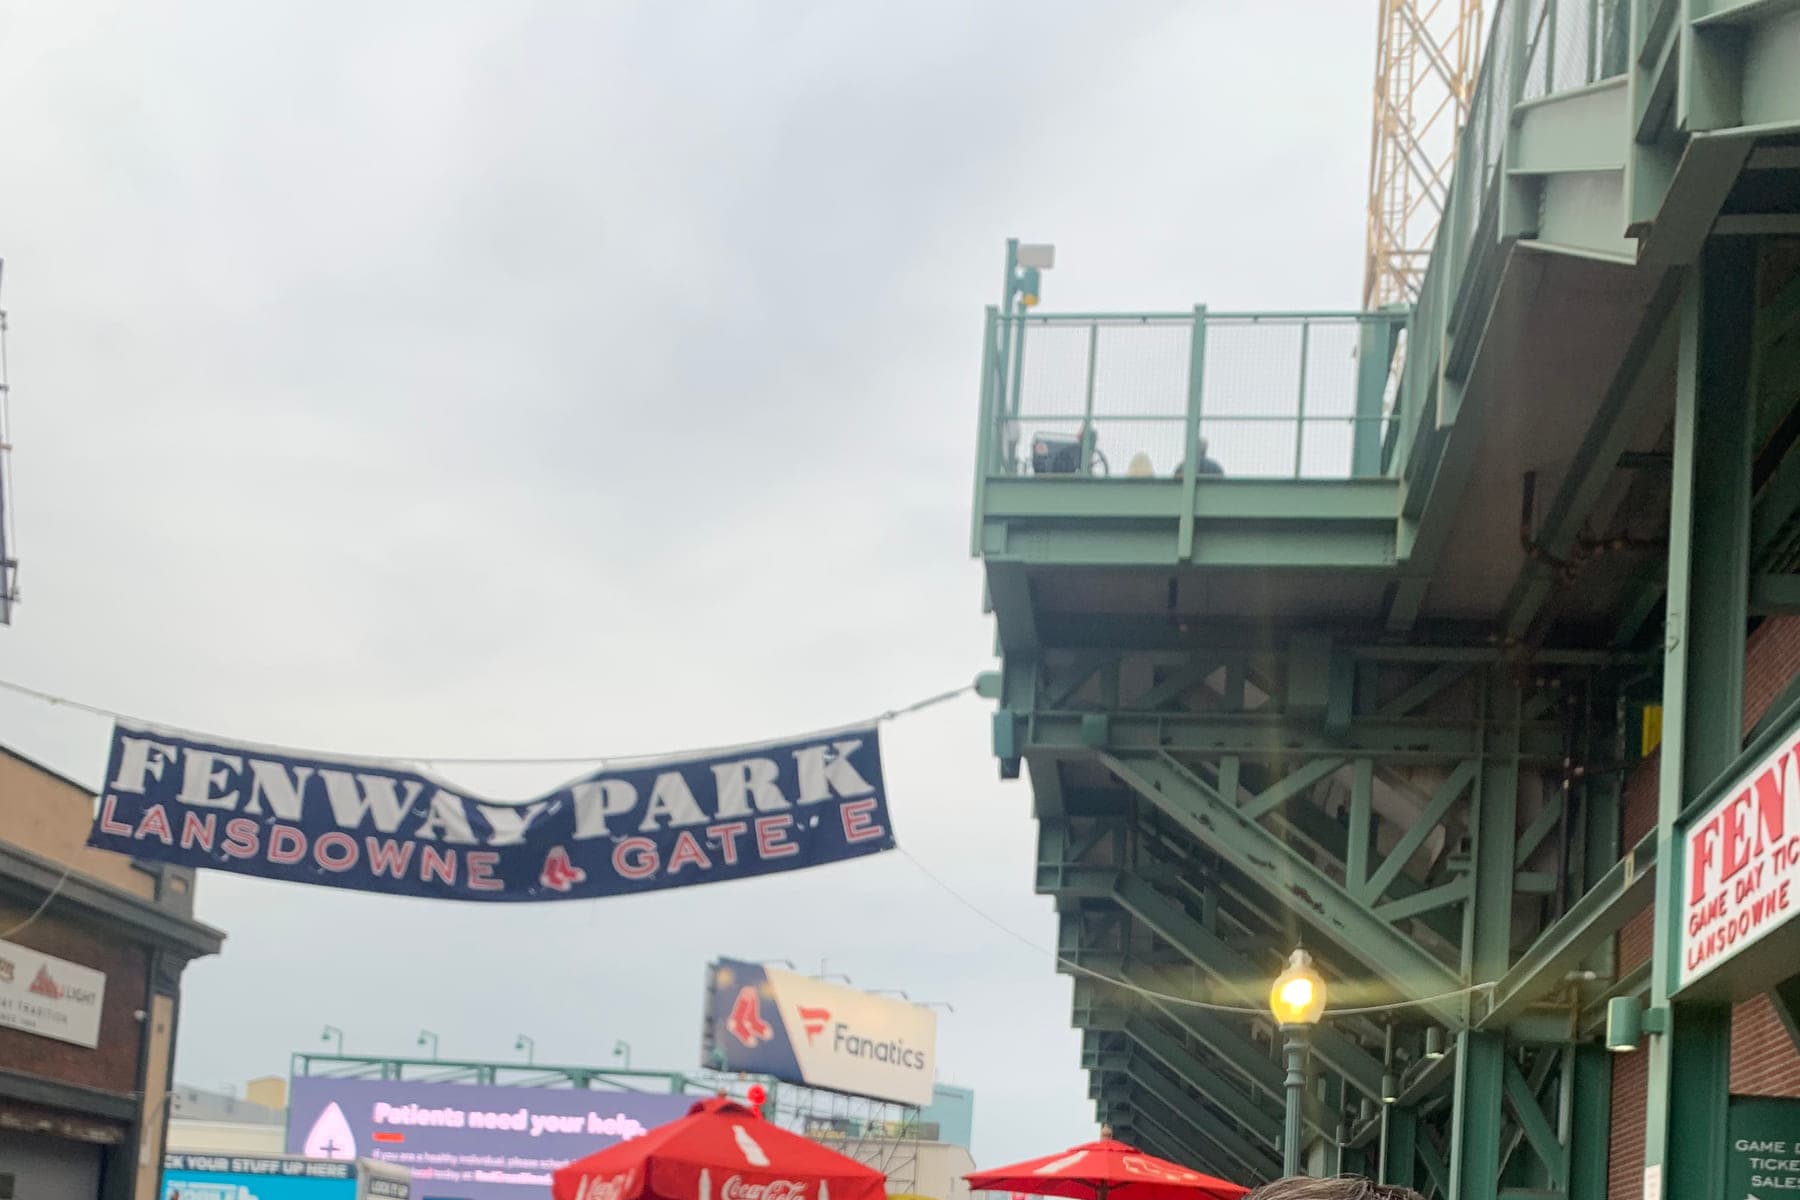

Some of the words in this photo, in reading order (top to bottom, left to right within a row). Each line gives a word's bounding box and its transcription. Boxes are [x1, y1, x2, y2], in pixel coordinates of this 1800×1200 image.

[110, 735, 549, 846] FENWAY
[572, 739, 875, 840] PARK
[101, 794, 505, 891] LANSDOWNE
[612, 814, 798, 879] GATE
[841, 798, 883, 843] E
[1690, 740, 1800, 906] FEN
[1687, 878, 1790, 971] LANSDOWNE
[1689, 889, 1728, 937] GAME
[1735, 861, 1763, 904] DAY
[833, 1022, 925, 1071] Fanatics
[373, 1102, 465, 1128] Patients
[468, 1108, 528, 1131] need
[530, 1113, 586, 1137] your
[1735, 1139, 1786, 1154] GAME
[188, 1156, 228, 1172] YOUR
[231, 1159, 280, 1174] STUFF
[283, 1161, 304, 1176] UP
[306, 1162, 348, 1178] HERE
[1748, 1157, 1800, 1171] TICKE
